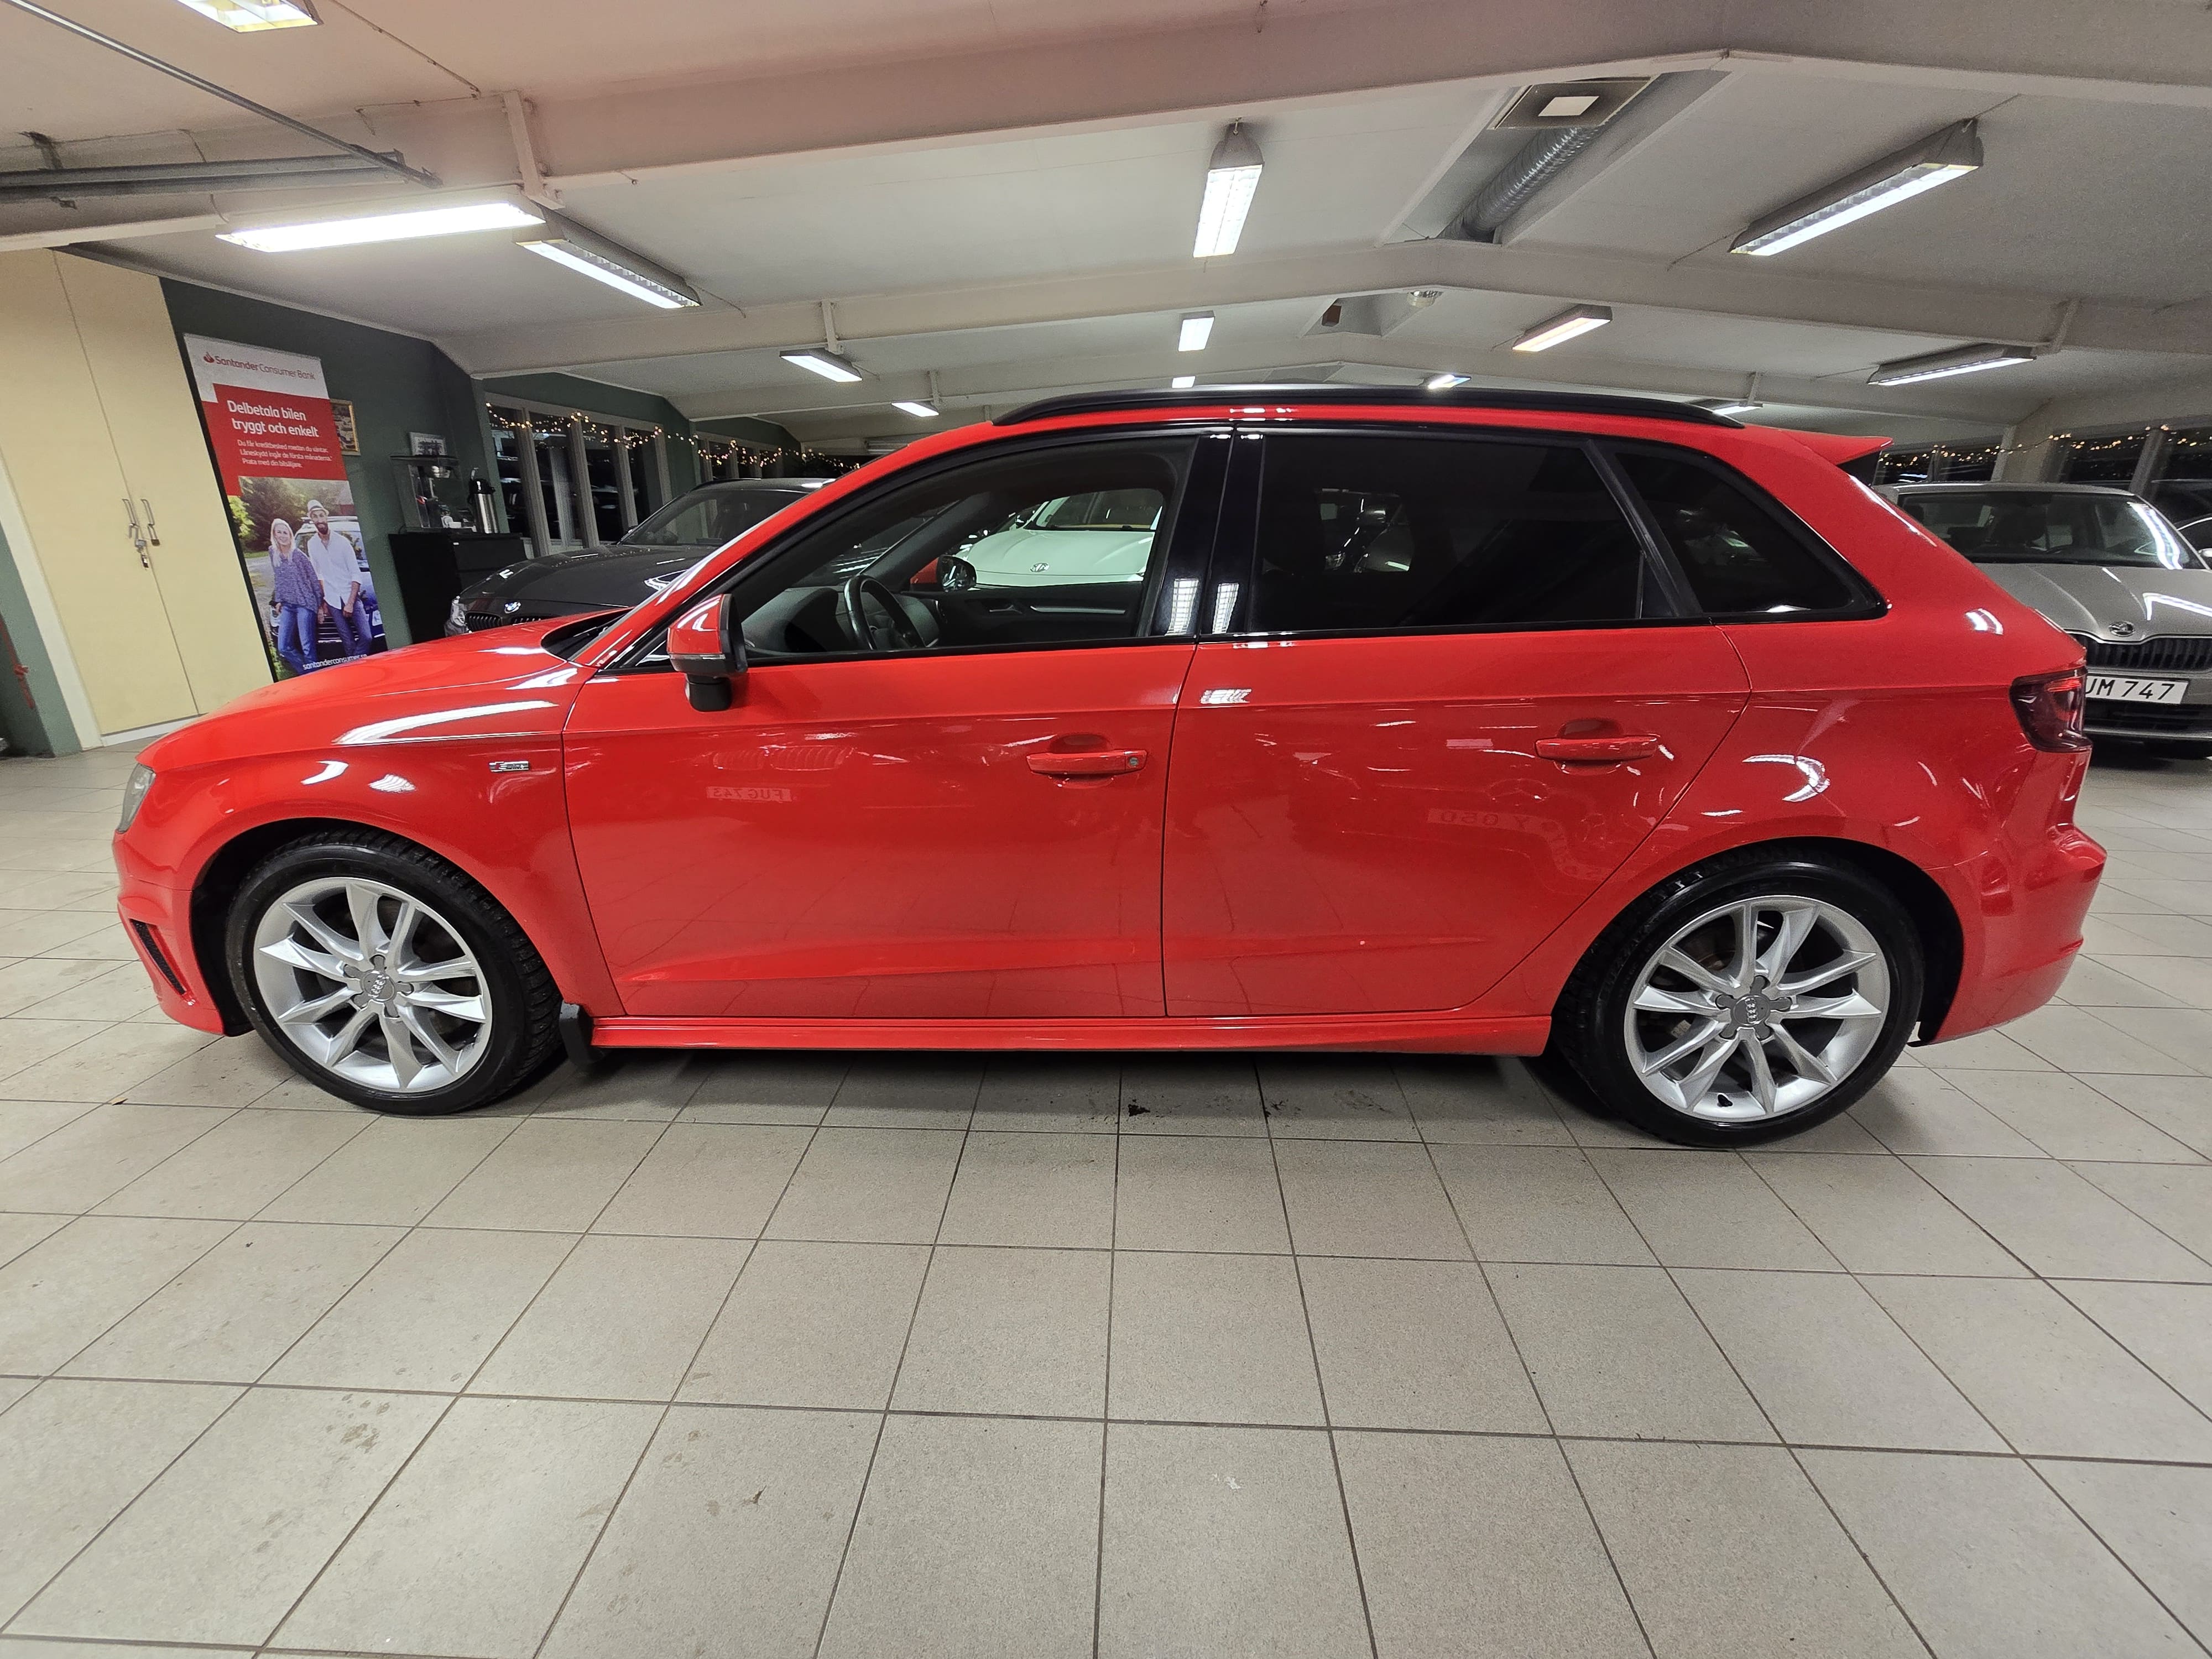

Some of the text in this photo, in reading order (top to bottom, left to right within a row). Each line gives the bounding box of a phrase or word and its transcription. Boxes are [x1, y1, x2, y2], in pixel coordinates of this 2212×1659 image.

[214, 356, 316, 380] Santander Consumer Bank
[227, 400, 307, 421] Delbetala bilen
[231, 418, 319, 437] tryggt och enkelt
[302, 654, 367, 670] santanderconsumer
[2121, 681, 2175, 700] 747
